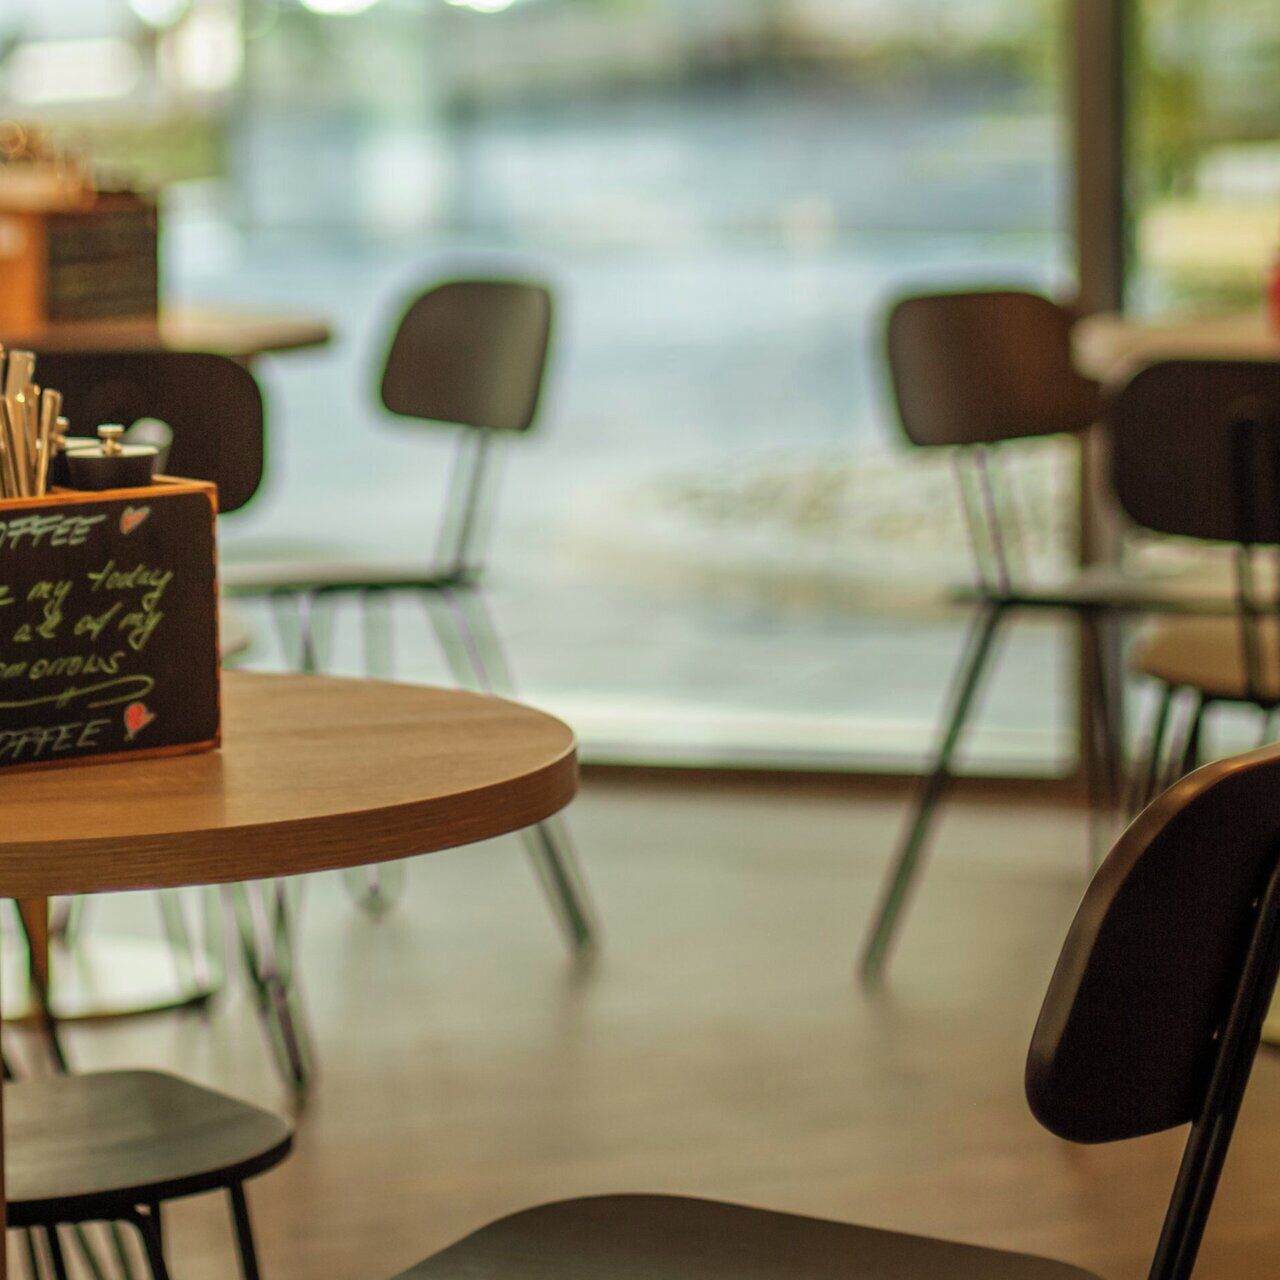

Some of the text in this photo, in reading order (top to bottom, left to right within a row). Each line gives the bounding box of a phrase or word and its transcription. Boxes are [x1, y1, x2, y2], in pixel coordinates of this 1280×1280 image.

[27, 581, 73, 618] my
[87, 559, 174, 612] today
[73, 601, 123, 640] of
[118, 611, 163, 650] my
